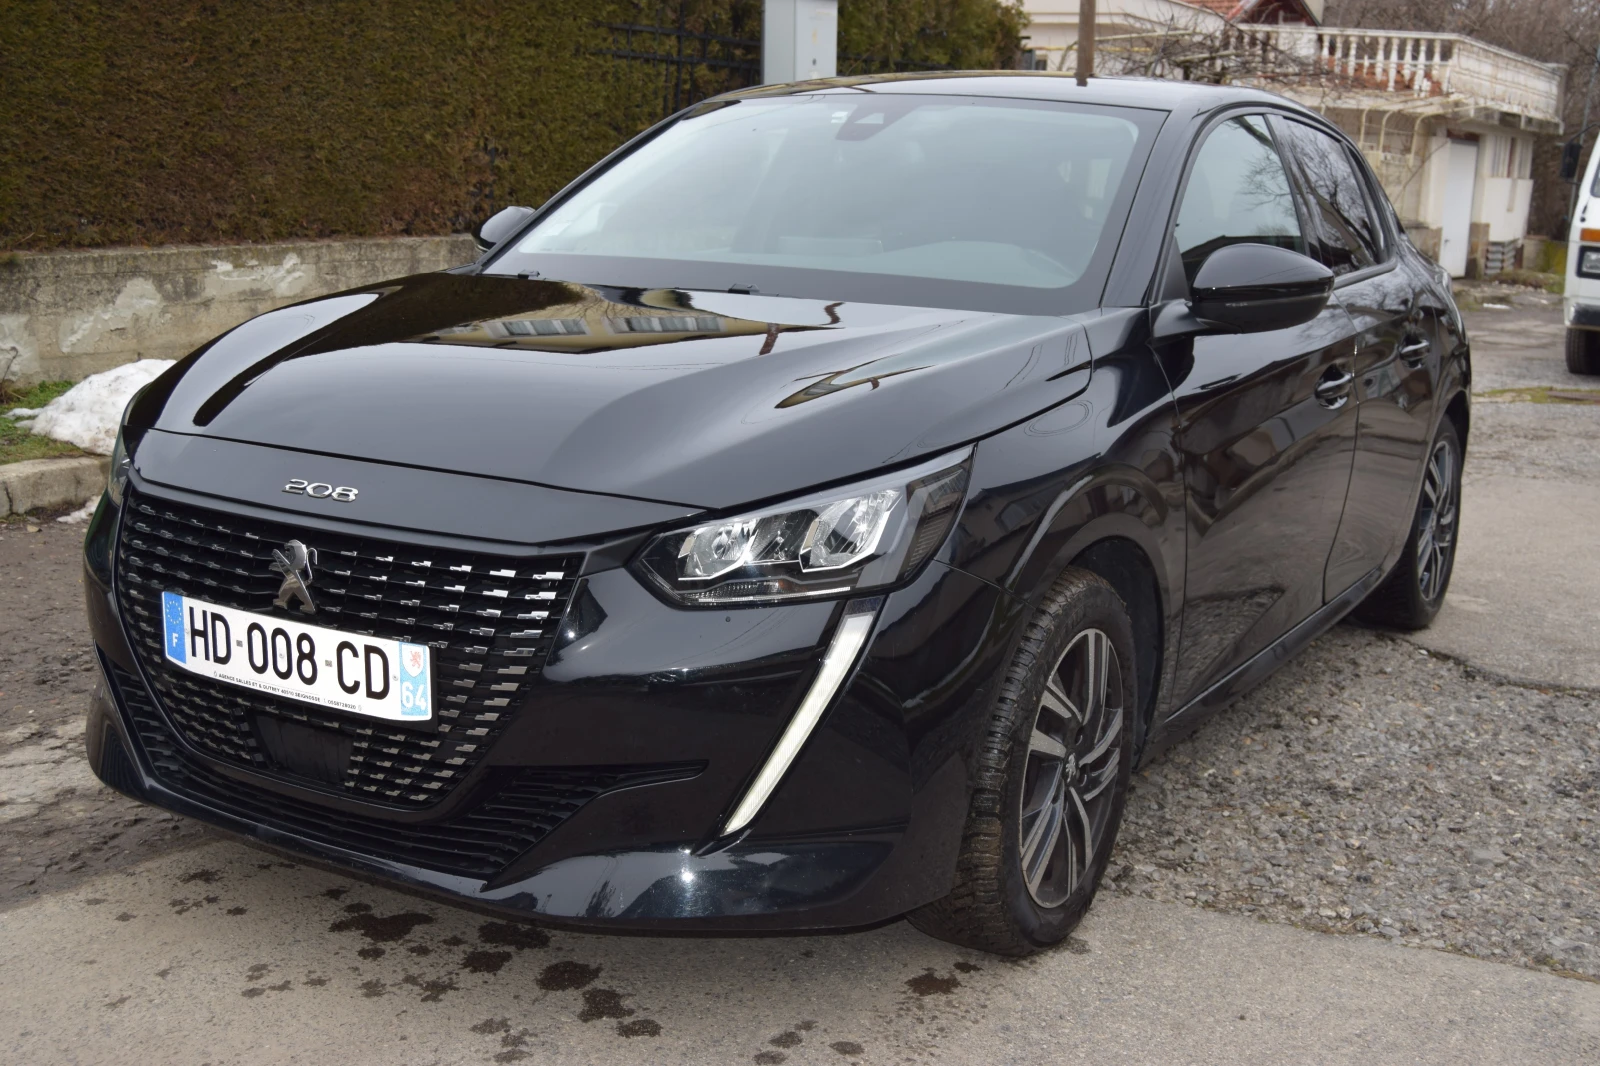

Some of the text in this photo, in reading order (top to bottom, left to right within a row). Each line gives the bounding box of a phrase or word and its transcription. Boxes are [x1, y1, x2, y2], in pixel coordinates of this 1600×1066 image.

[282, 478, 359, 502] 208
[172, 632, 179, 647] F
[401, 681, 427, 711] 64
